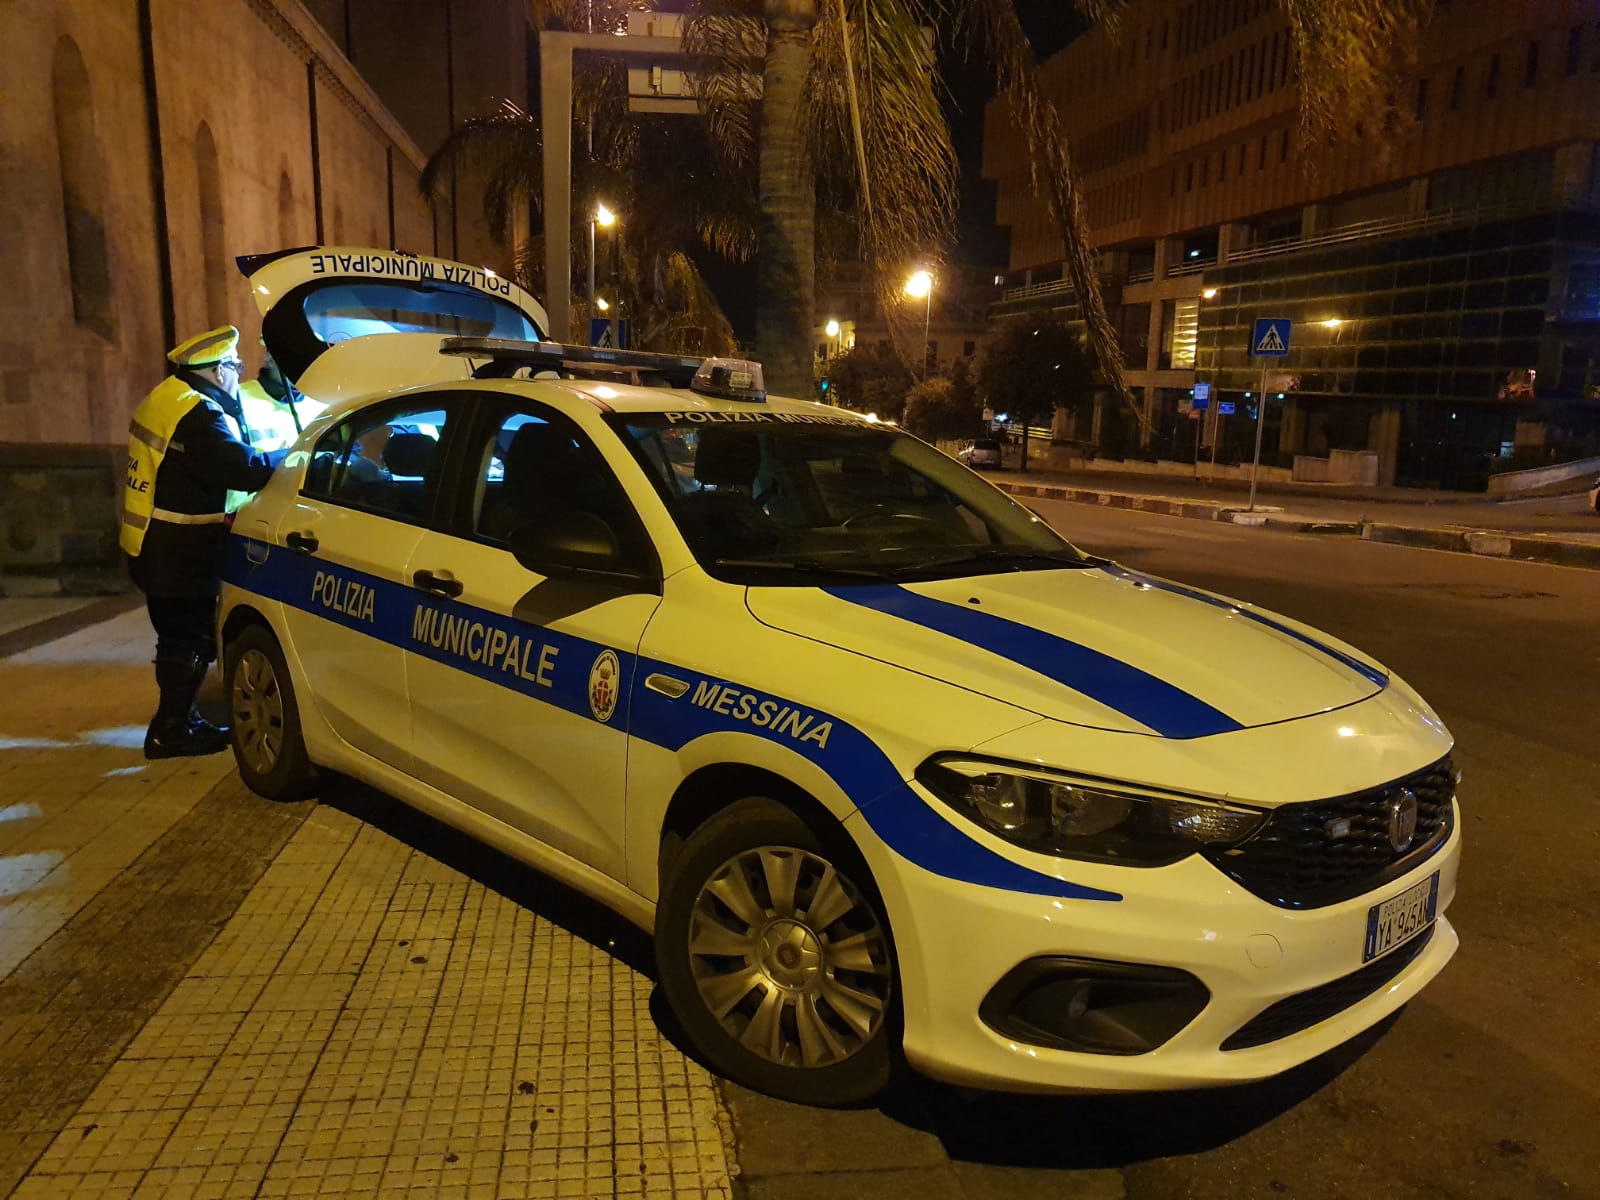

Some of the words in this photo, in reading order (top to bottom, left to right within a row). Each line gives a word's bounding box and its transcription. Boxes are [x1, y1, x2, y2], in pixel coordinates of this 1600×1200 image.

[310, 255, 434, 280] MUNICIPALE
[442, 264, 510, 296] POLIZIA
[664, 411, 771, 425] POLIZIA
[311, 570, 376, 624] POLIZIA
[412, 604, 560, 689] MUNICIPALE
[691, 679, 834, 750] MESSINA
[1379, 918, 1392, 951] YA
